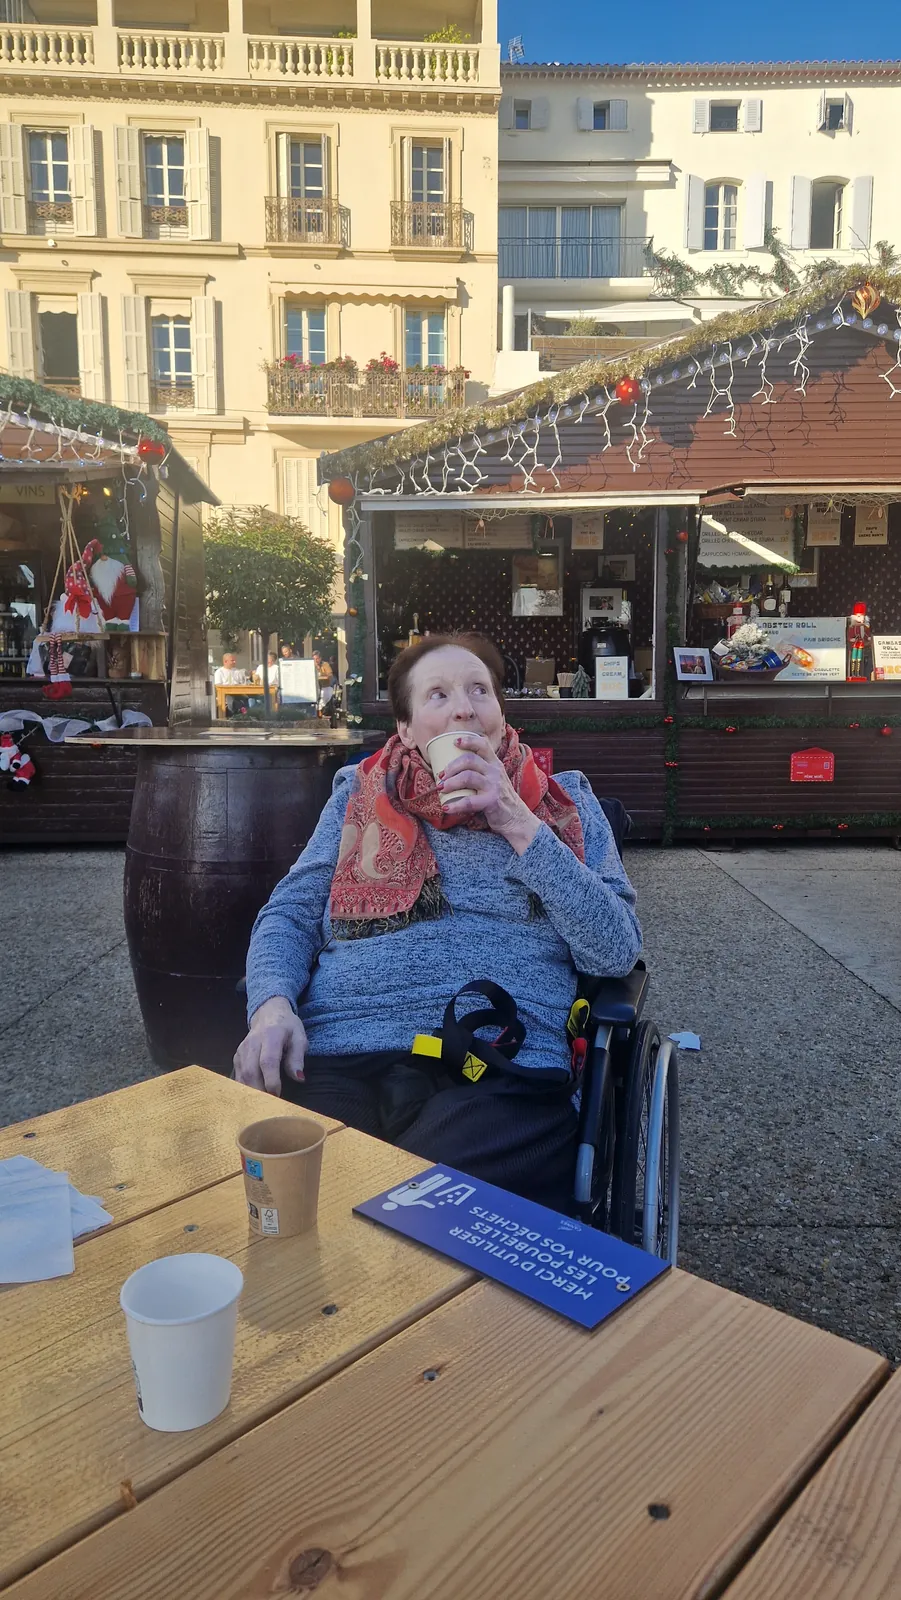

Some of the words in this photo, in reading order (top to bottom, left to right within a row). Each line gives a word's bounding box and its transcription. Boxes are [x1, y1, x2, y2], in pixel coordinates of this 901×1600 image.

[15, 485, 45, 497] VINS
[468, 1205, 542, 1242] DÉCHETS
[449, 1226, 537, 1275] D'UTILISER
[471, 1222, 562, 1271] POUBELLES
[540, 1237, 574, 1260] VOS
[535, 1267, 595, 1301] MERCI
[568, 1266, 599, 1286] LES
[577, 1253, 632, 1285] POUR
